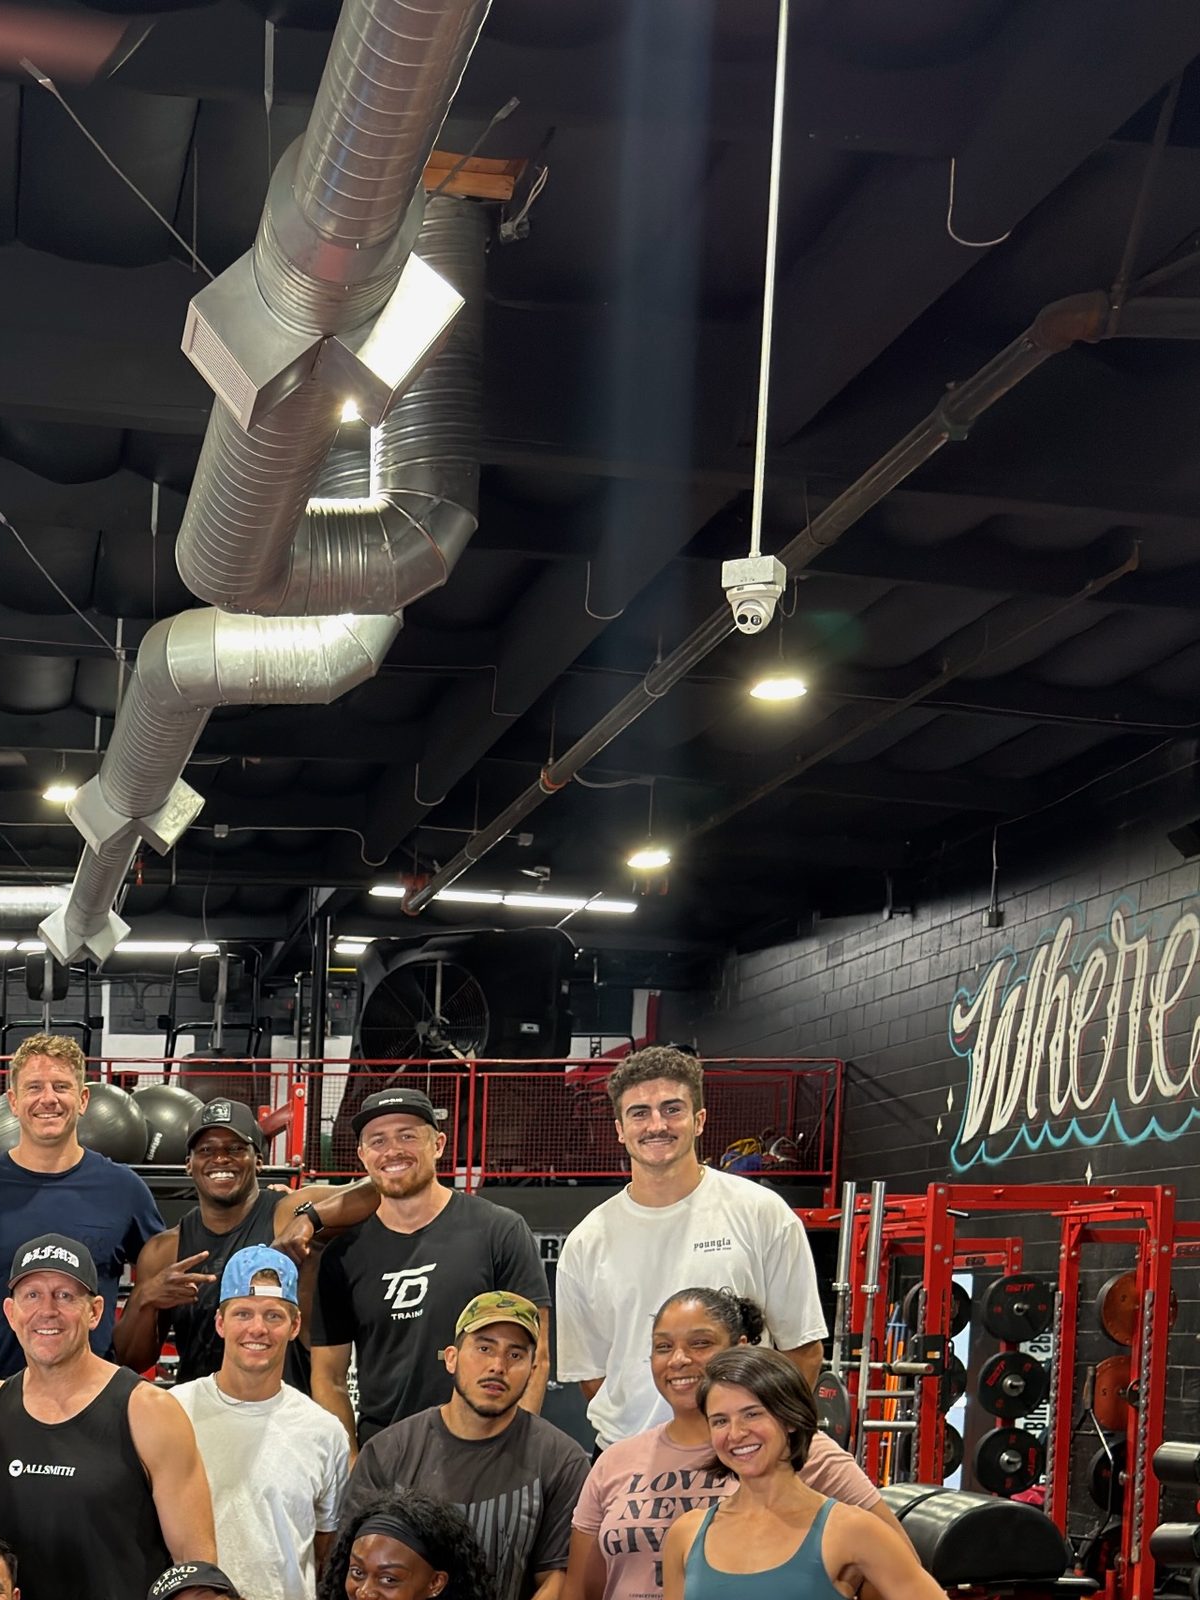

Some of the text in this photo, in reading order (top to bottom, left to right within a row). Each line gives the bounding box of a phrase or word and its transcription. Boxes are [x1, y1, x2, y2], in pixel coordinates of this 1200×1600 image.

[23, 1464, 76, 1476] ALLSMITH
[604, 1527, 669, 1556] GIV
[152, 1565, 198, 1595] SLFMD
[161, 1574, 188, 1592] FAMILY
